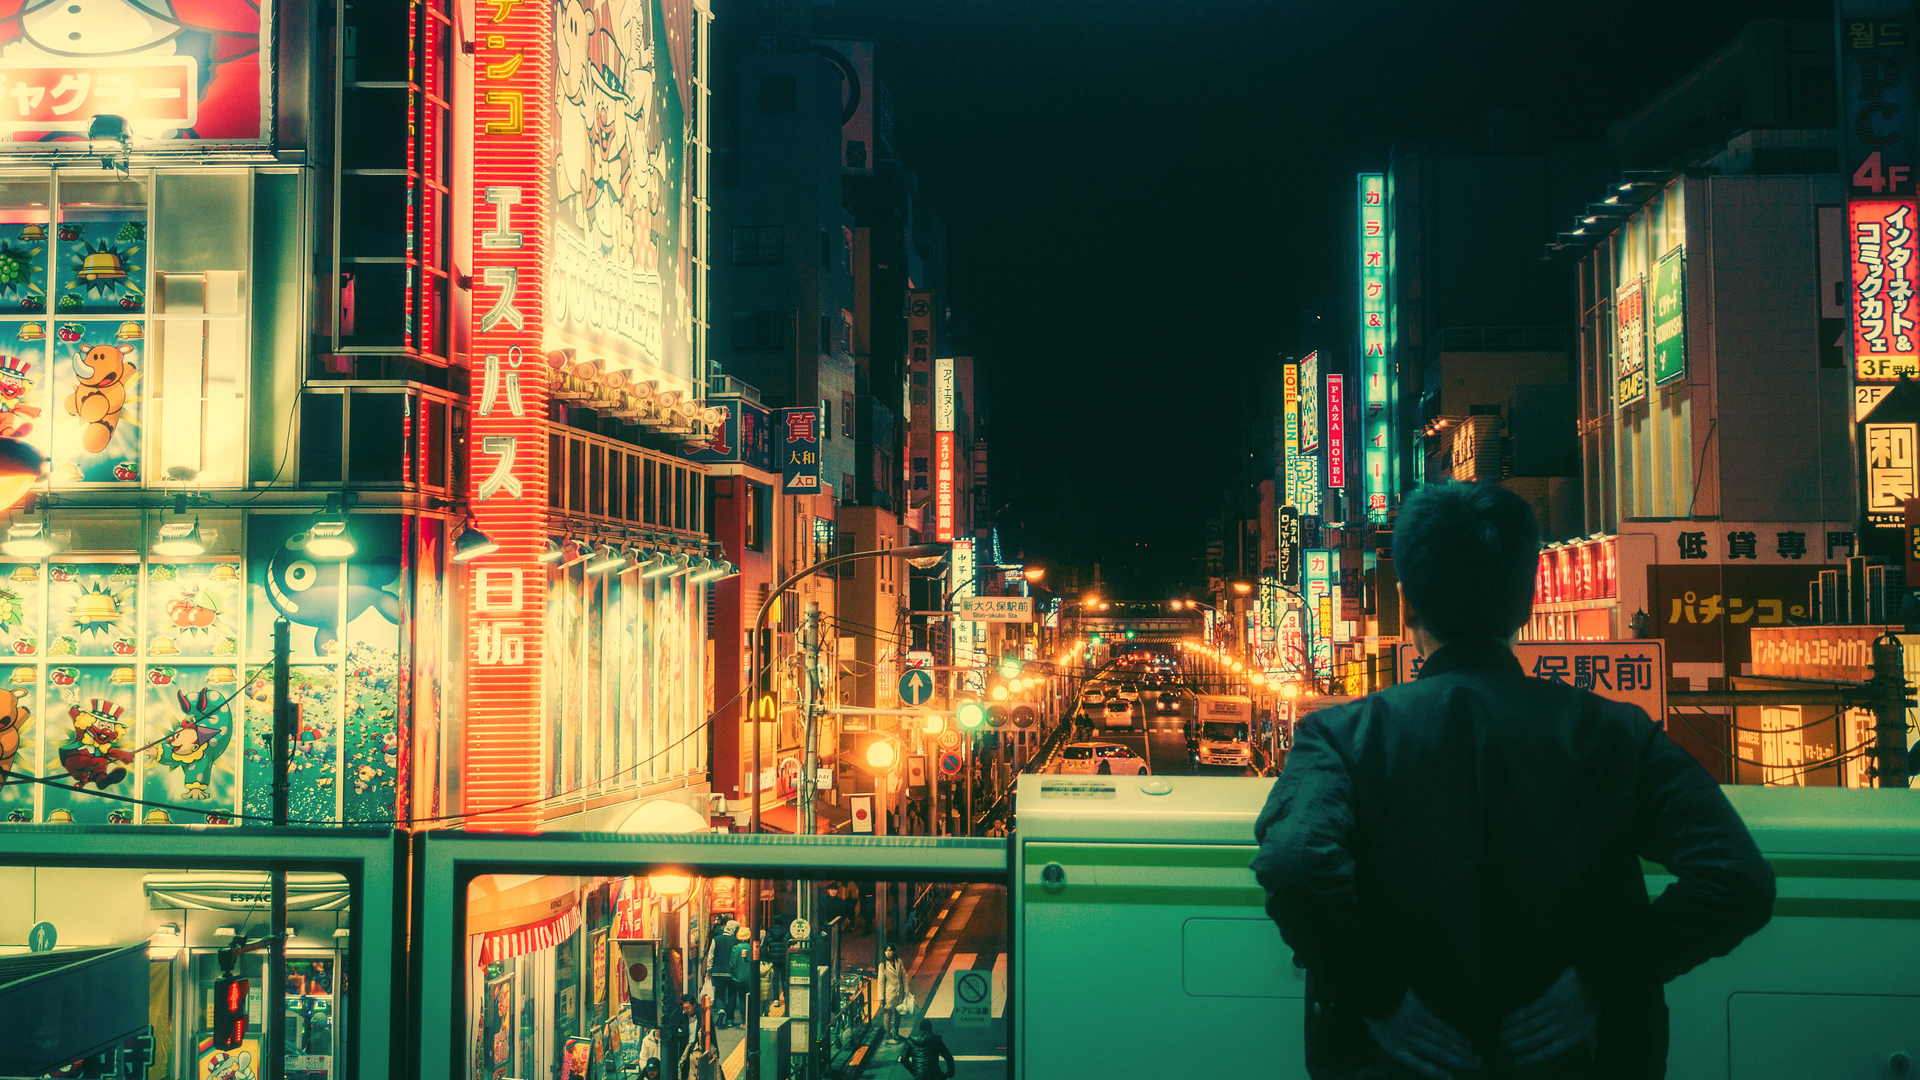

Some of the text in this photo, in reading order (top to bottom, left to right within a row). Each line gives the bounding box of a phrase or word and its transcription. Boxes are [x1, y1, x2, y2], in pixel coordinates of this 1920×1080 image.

[1850, 22, 1904, 48] 월드
[0, 72, 182, 117] ャグラー
[1853, 151, 1911, 193] 4F
[1858, 223, 1888, 352] コミックカフェ
[1885, 206, 1915, 352] インターネット&
[1365, 190, 1387, 510] カラオケ&パーティー館
[1862, 359, 1892, 376] 3F
[1285, 367, 1296, 405] HOTEL
[1858, 388, 1882, 403] 2F
[473, 186, 525, 665] エスパス 日拓
[783, 411, 817, 443] 質
[1286, 412, 1297, 441] SUN
[1331, 386, 1341, 484] PLAZA HOTEL
[788, 450, 815, 465] 大和
[795, 477, 815, 487] 入口
[1295, 460, 1313, 515] ネットルー
[1290, 519, 1298, 543] ホテル
[1868, 514, 1905, 522] wa-ta-
[1677, 530, 1854, 560] 低貸専門
[963, 601, 1028, 612] 新大久保駅前
[945, 733, 956, 744] 40
[1738, 730, 1760, 745] JAPANESE
[230, 894, 272, 902] ESPAC
